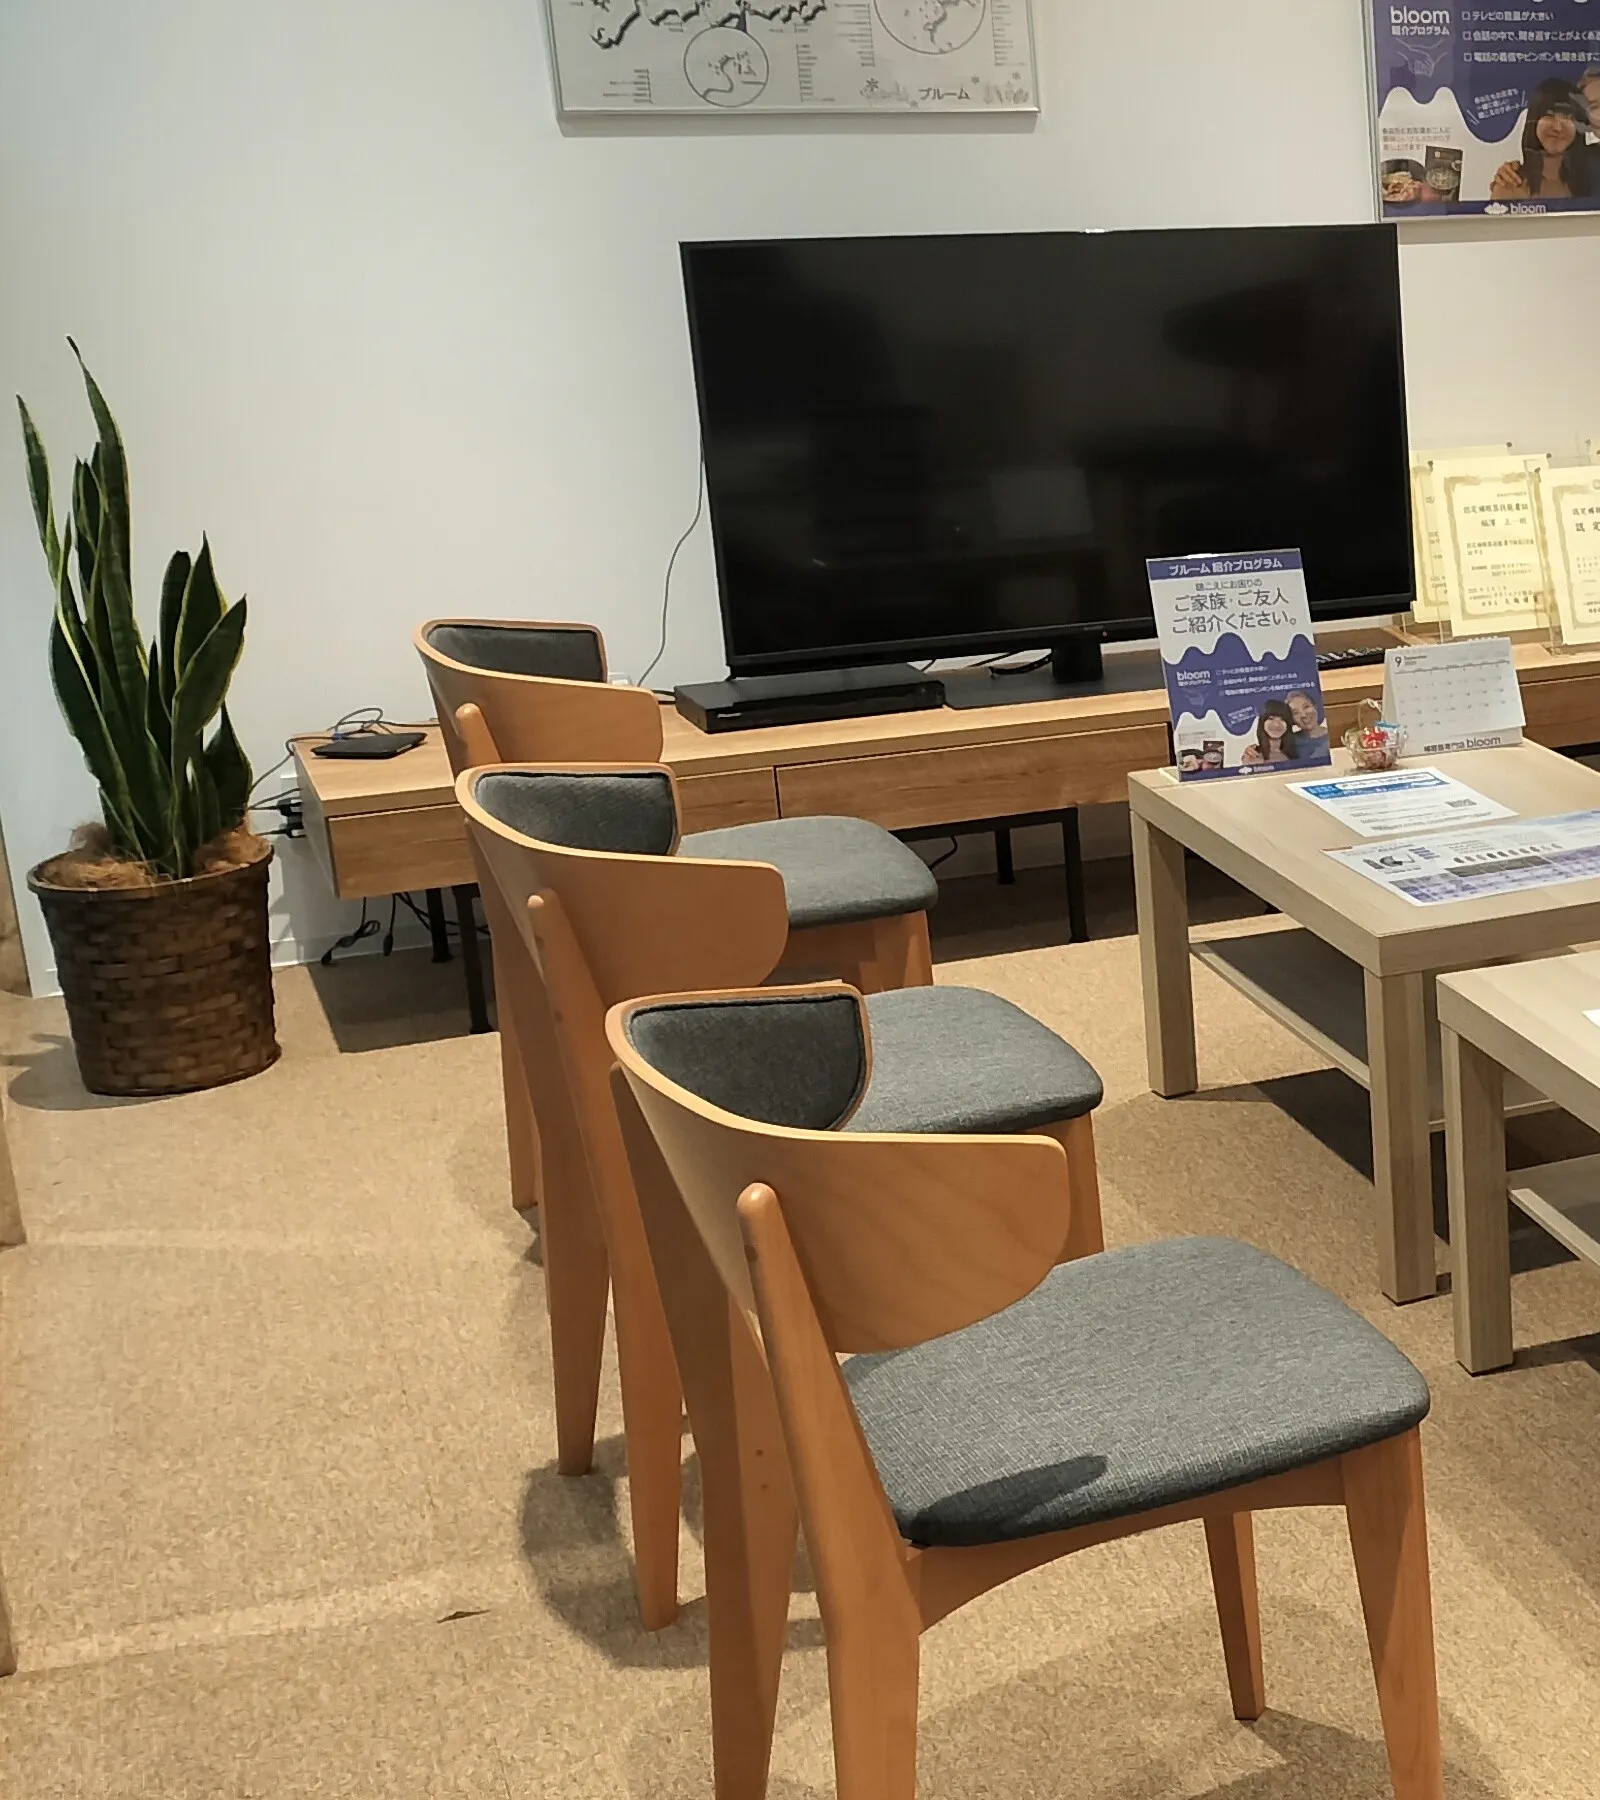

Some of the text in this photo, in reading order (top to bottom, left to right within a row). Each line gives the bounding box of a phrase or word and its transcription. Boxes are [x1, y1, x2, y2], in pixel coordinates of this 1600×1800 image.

[1390, 7, 1450, 24] bloom
[1391, 25, 1450, 35] 紹介プログラム
[917, 87, 971, 100] ブルーム
[1510, 203, 1546, 214] bloom
[1169, 558, 1283, 576] ブルーム 紹介プログラム
[1174, 587, 1290, 612] ご家族・ご友人
[1173, 611, 1297, 634] ご紹介ください。
[1176, 669, 1211, 681] bloom
[1466, 736, 1501, 748] bloom
